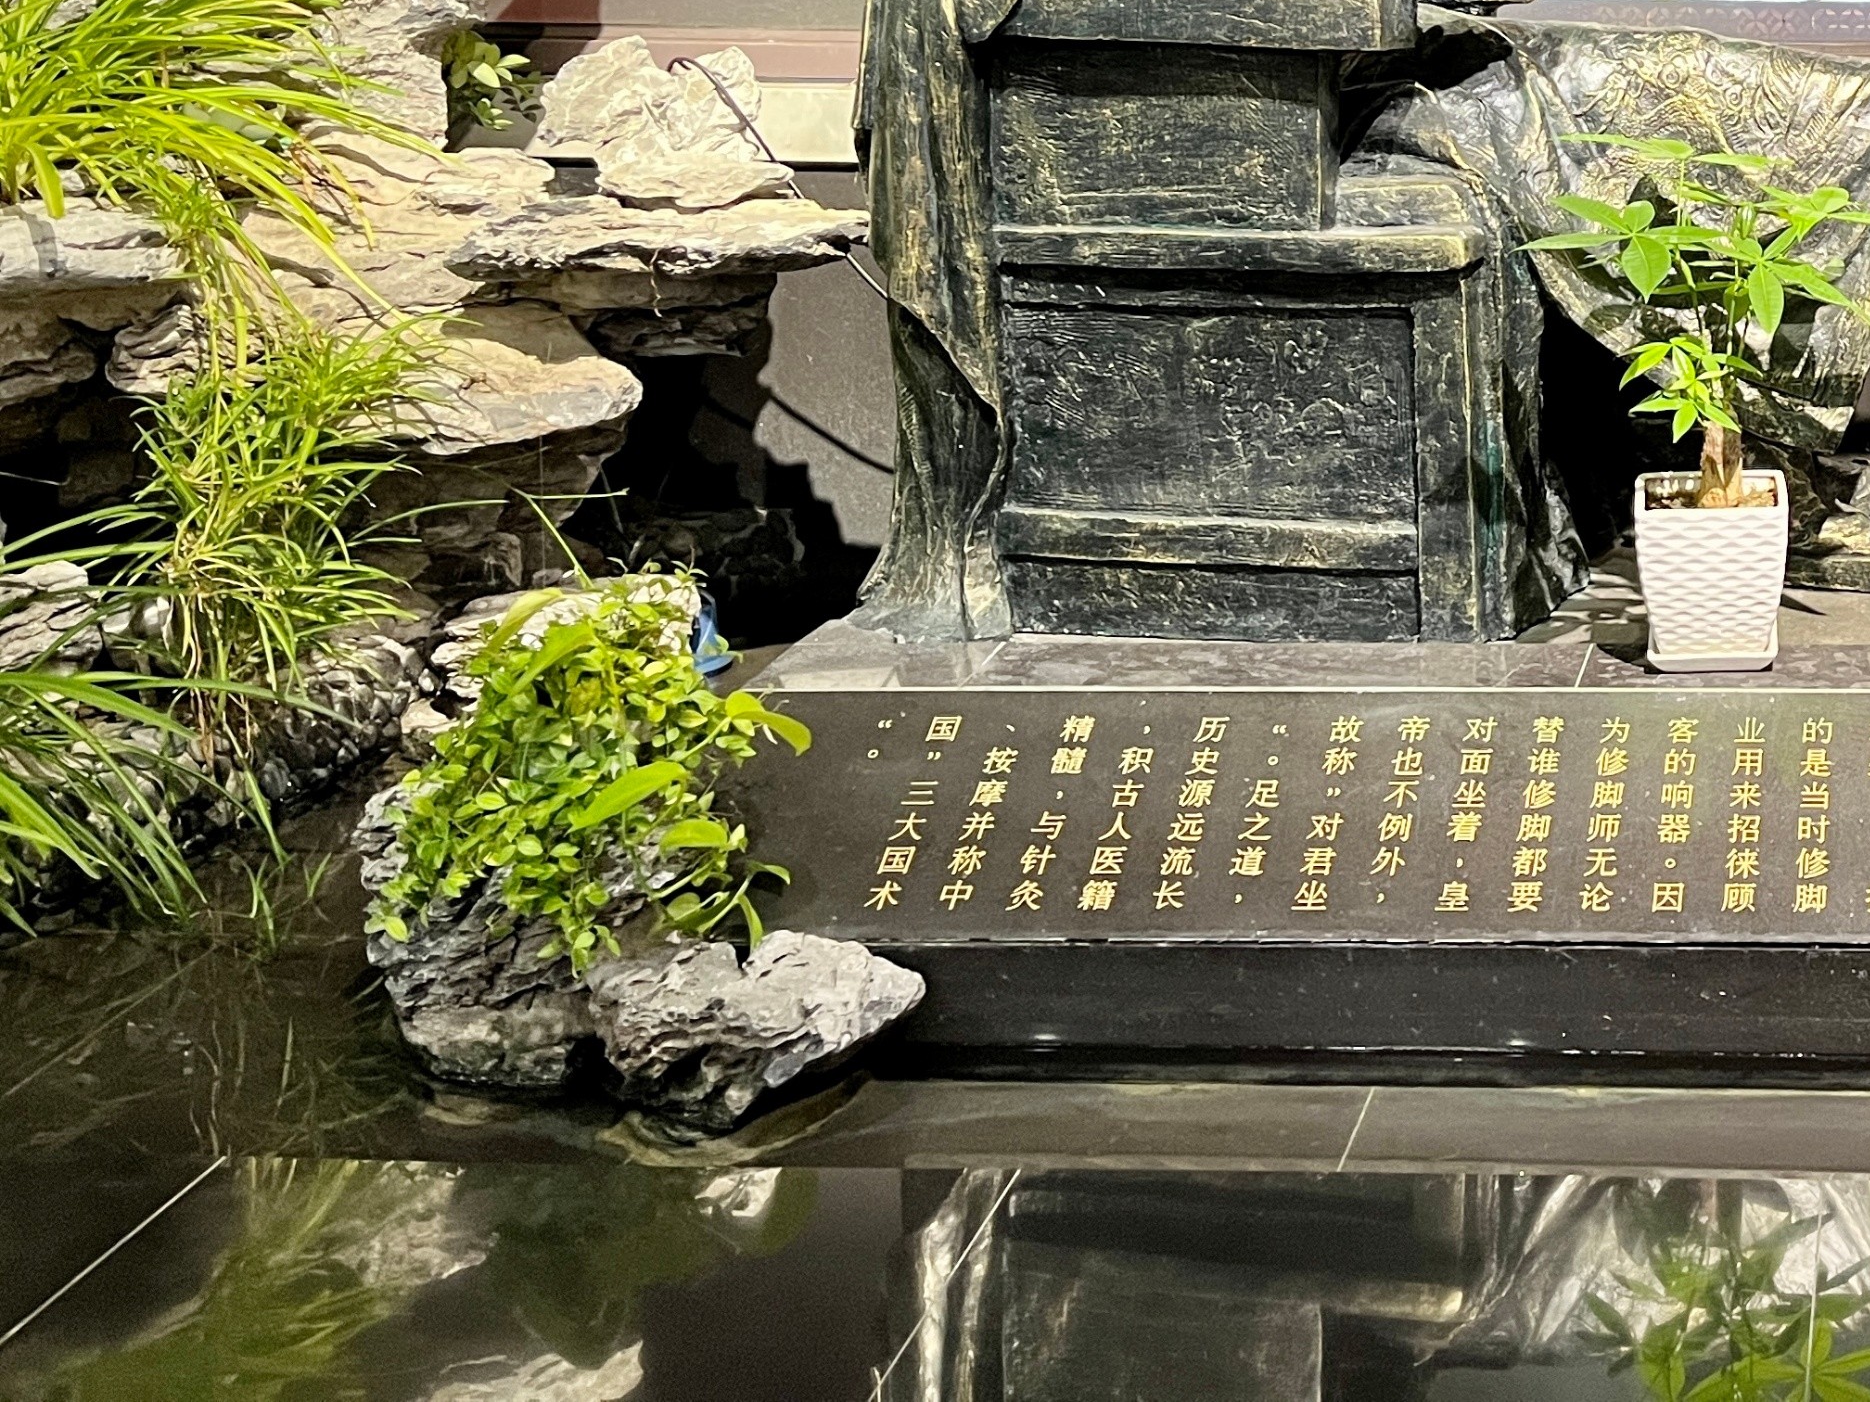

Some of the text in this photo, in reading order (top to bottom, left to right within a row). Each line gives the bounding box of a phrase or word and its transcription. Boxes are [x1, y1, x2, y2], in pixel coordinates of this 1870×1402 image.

[1153, 717, 1230, 909] 历史源远流长
[1507, 717, 1564, 912] 替谁修脚都要
[1579, 717, 1630, 912] 为修脚师无论
[1721, 717, 1766, 912] 业用来招徕顾
[1793, 717, 1833, 913] 的是当时修脚
